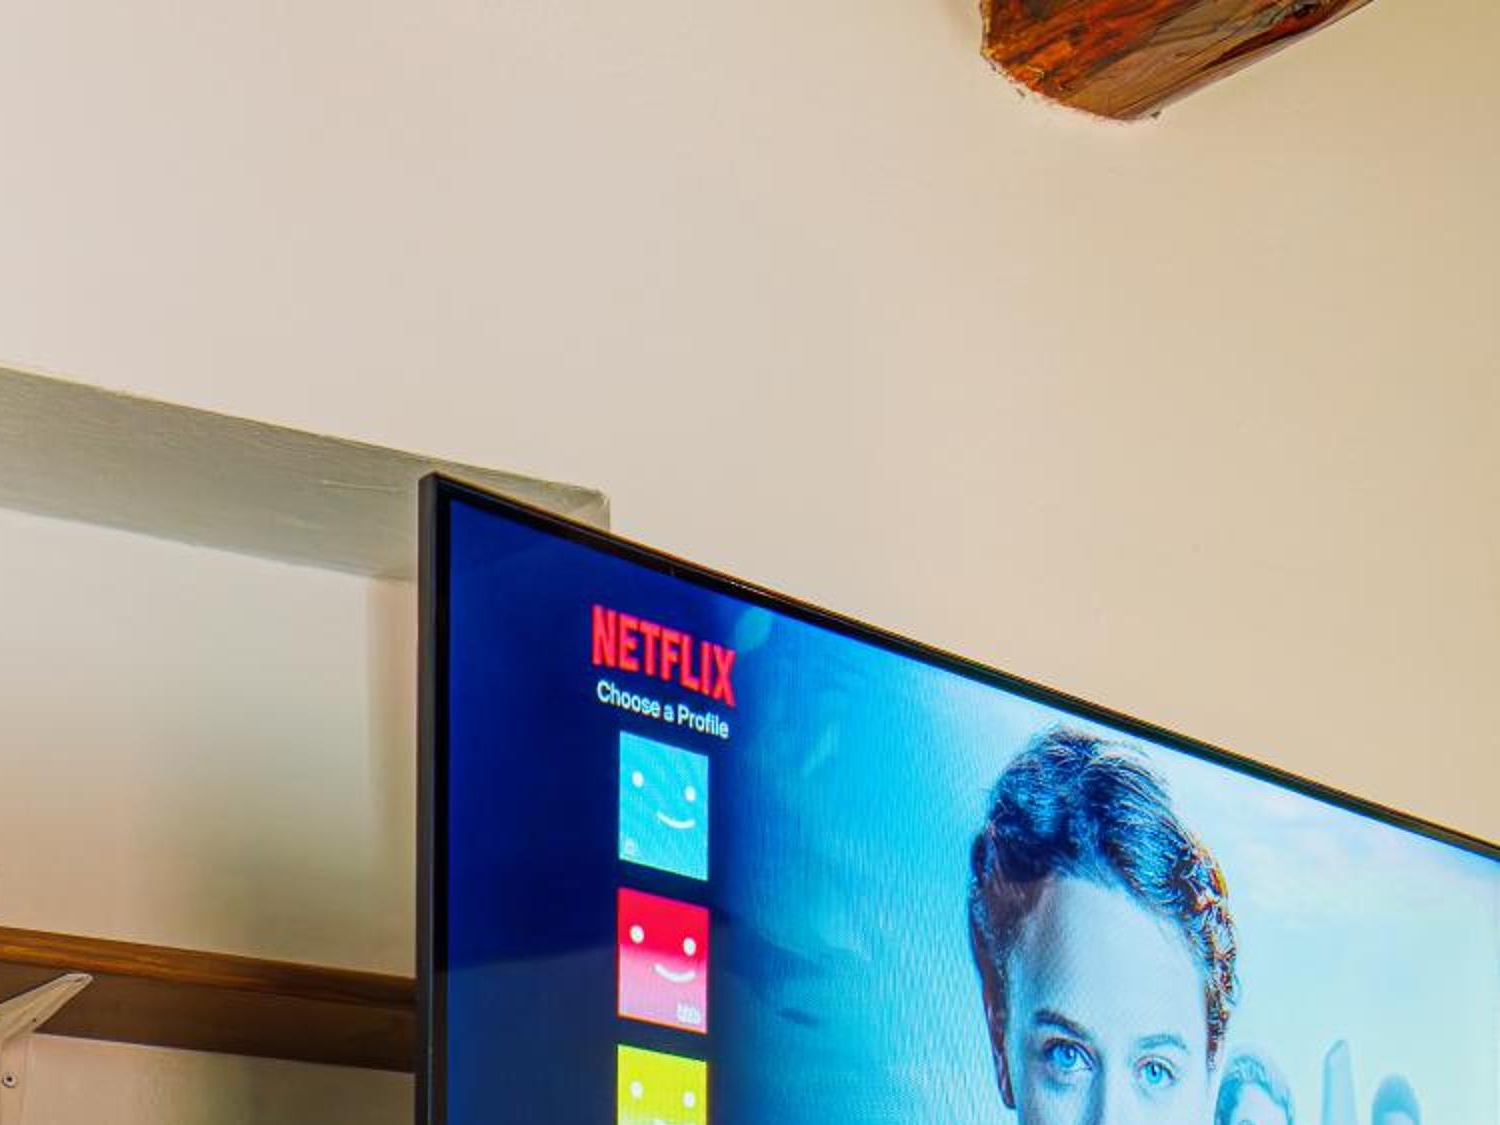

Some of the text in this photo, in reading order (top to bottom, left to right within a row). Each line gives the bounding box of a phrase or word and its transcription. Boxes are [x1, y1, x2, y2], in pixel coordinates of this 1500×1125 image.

[592, 604, 737, 709] NETFLIX
[596, 680, 730, 740] Choose a Profile
